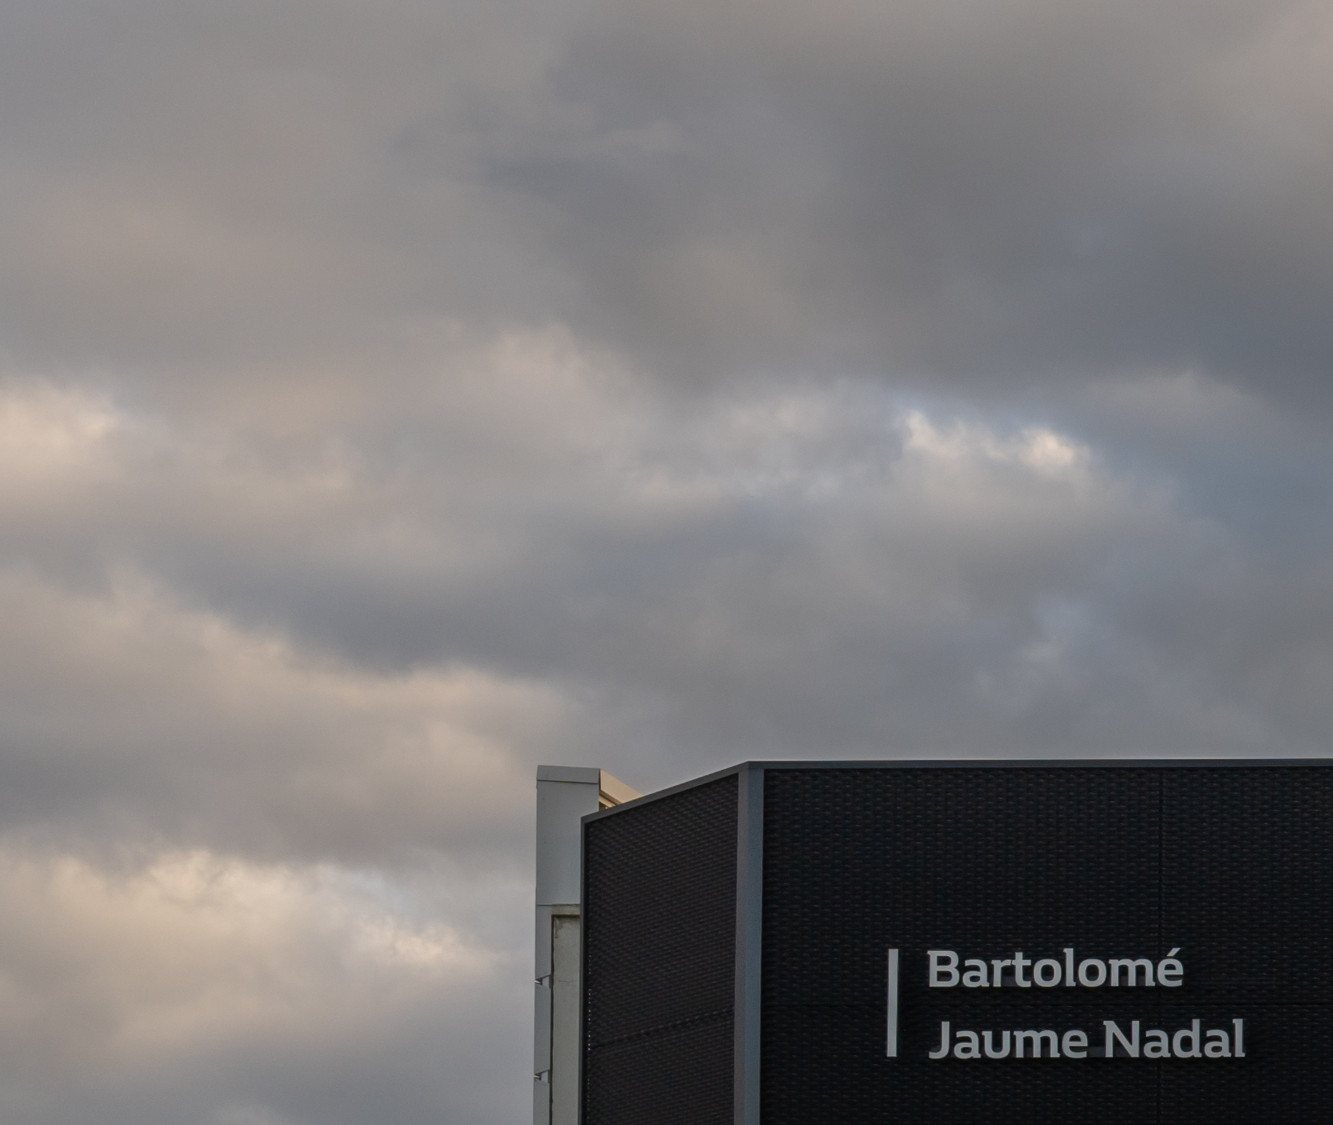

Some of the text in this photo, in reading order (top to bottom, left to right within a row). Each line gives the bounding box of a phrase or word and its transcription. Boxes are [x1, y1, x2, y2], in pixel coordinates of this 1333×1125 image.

[926, 947, 1184, 988] Bartolomé
[928, 1018, 1246, 1060] Jaume Nadal
